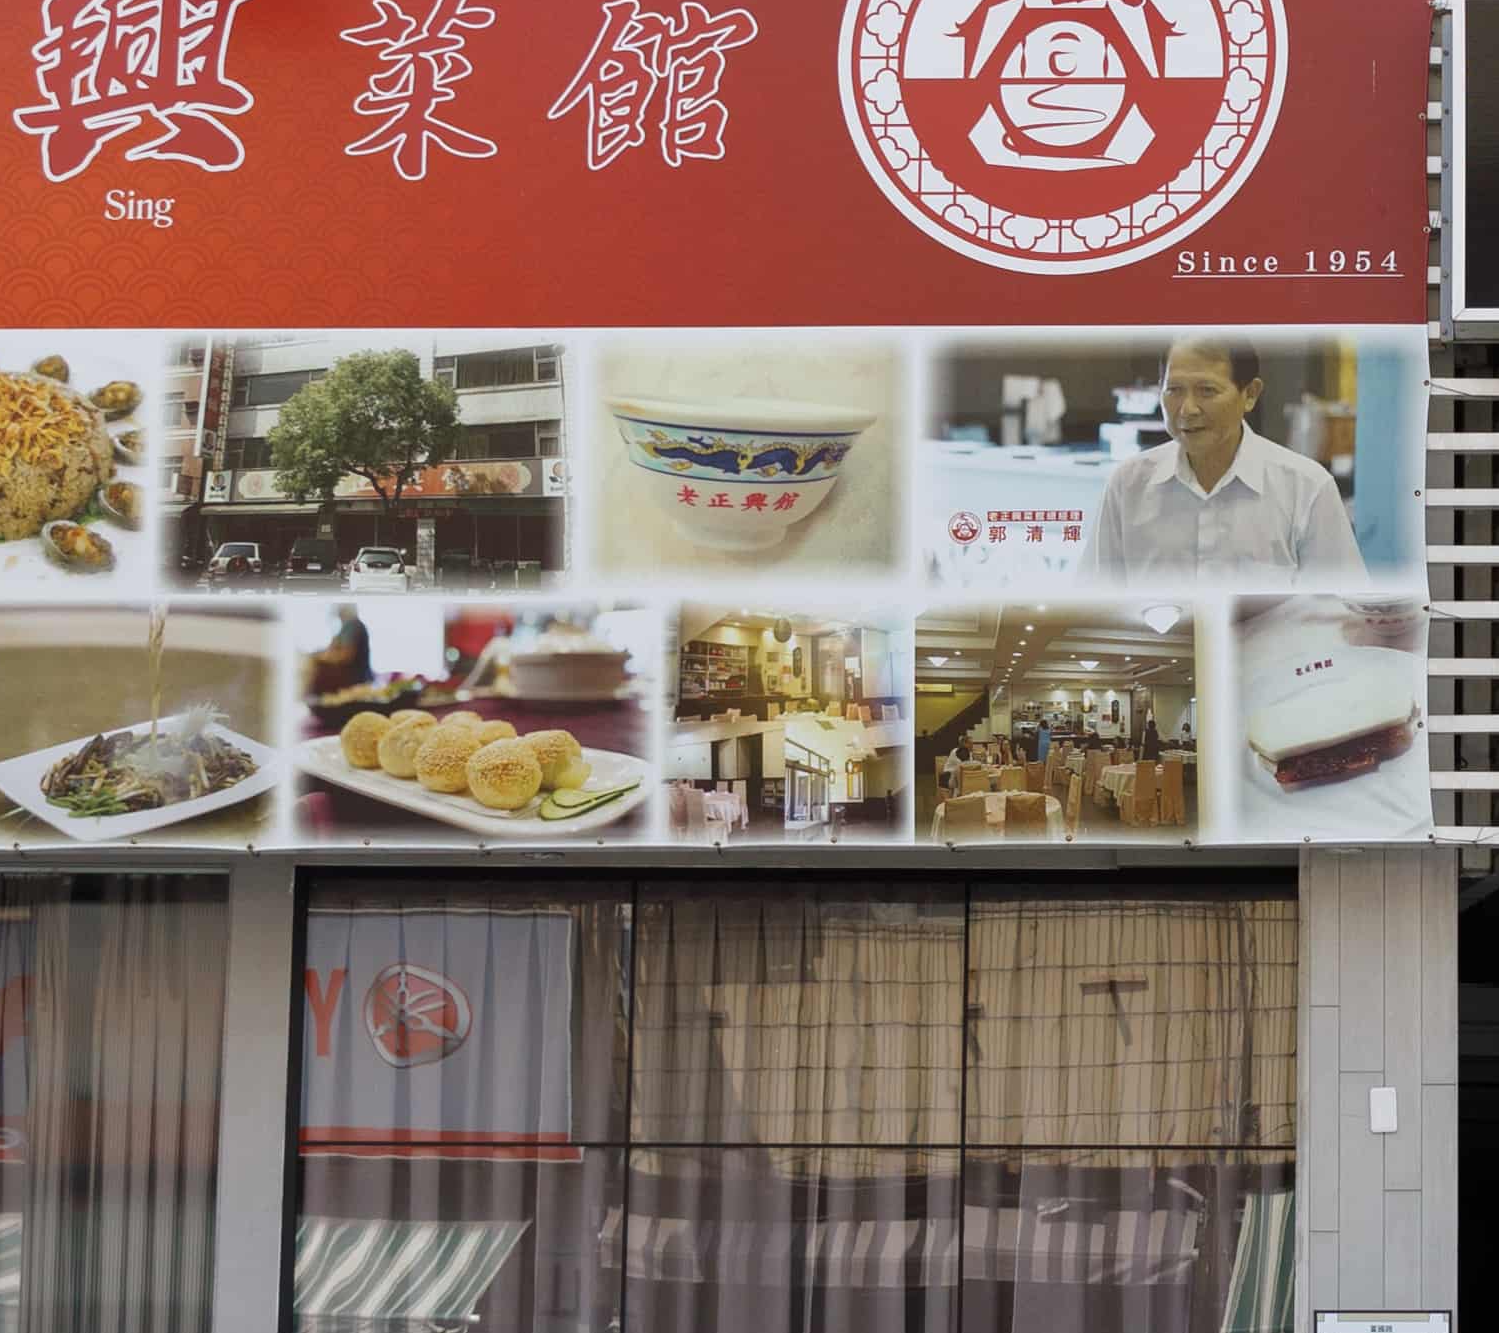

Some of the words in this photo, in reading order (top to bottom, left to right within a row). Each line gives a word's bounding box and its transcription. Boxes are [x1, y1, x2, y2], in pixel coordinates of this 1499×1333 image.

[103, 189, 175, 229] Sing
[1176, 248, 1281, 274] Since
[1303, 248, 1401, 273] 1954
[988, 523, 1083, 544] 郭清輝
